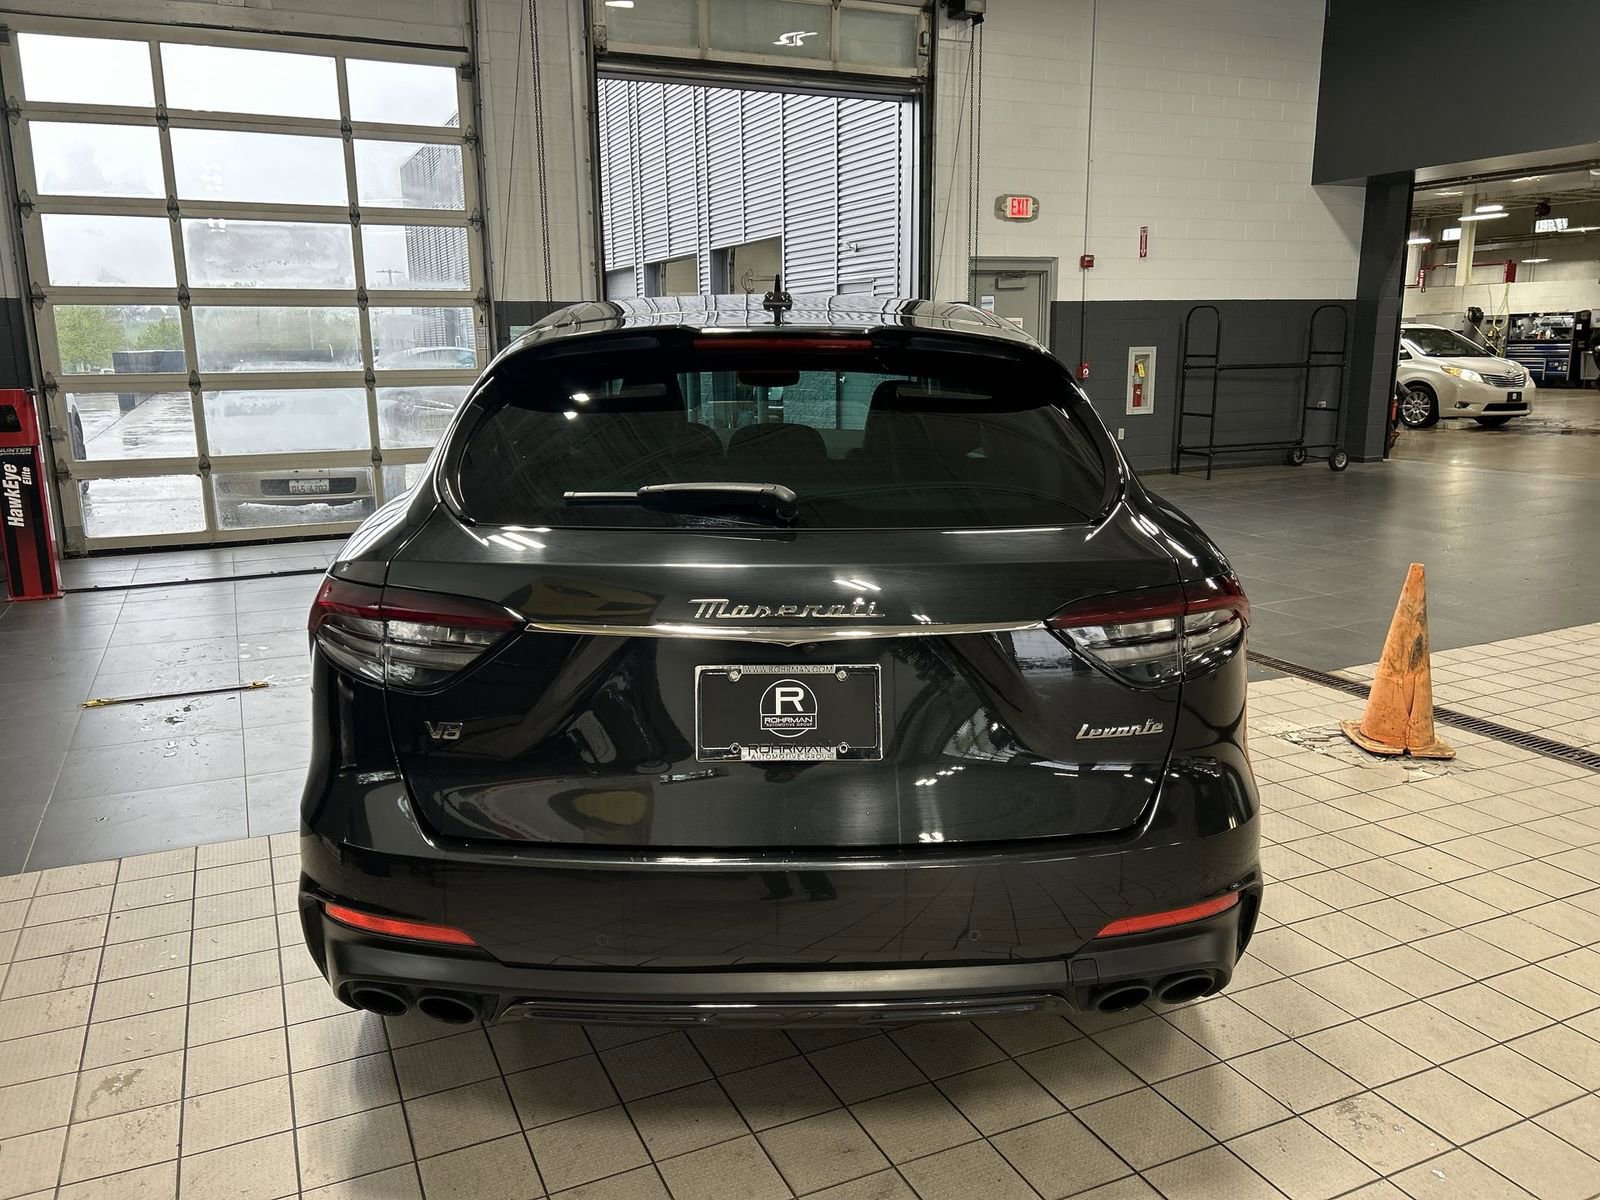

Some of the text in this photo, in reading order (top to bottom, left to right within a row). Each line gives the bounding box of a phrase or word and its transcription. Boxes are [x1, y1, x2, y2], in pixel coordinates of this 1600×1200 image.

[1011, 198, 1030, 216] EXIT
[479, 314, 484, 325] 4
[22, 467, 32, 485] Elite
[3, 463, 25, 527] HawkEye
[688, 597, 885, 619] Maserati
[775, 687, 805, 715] R
[764, 715, 813, 725] ROHRMAN
[1075, 718, 1164, 740] Levante
[748, 743, 832, 756] ROHRMAN
